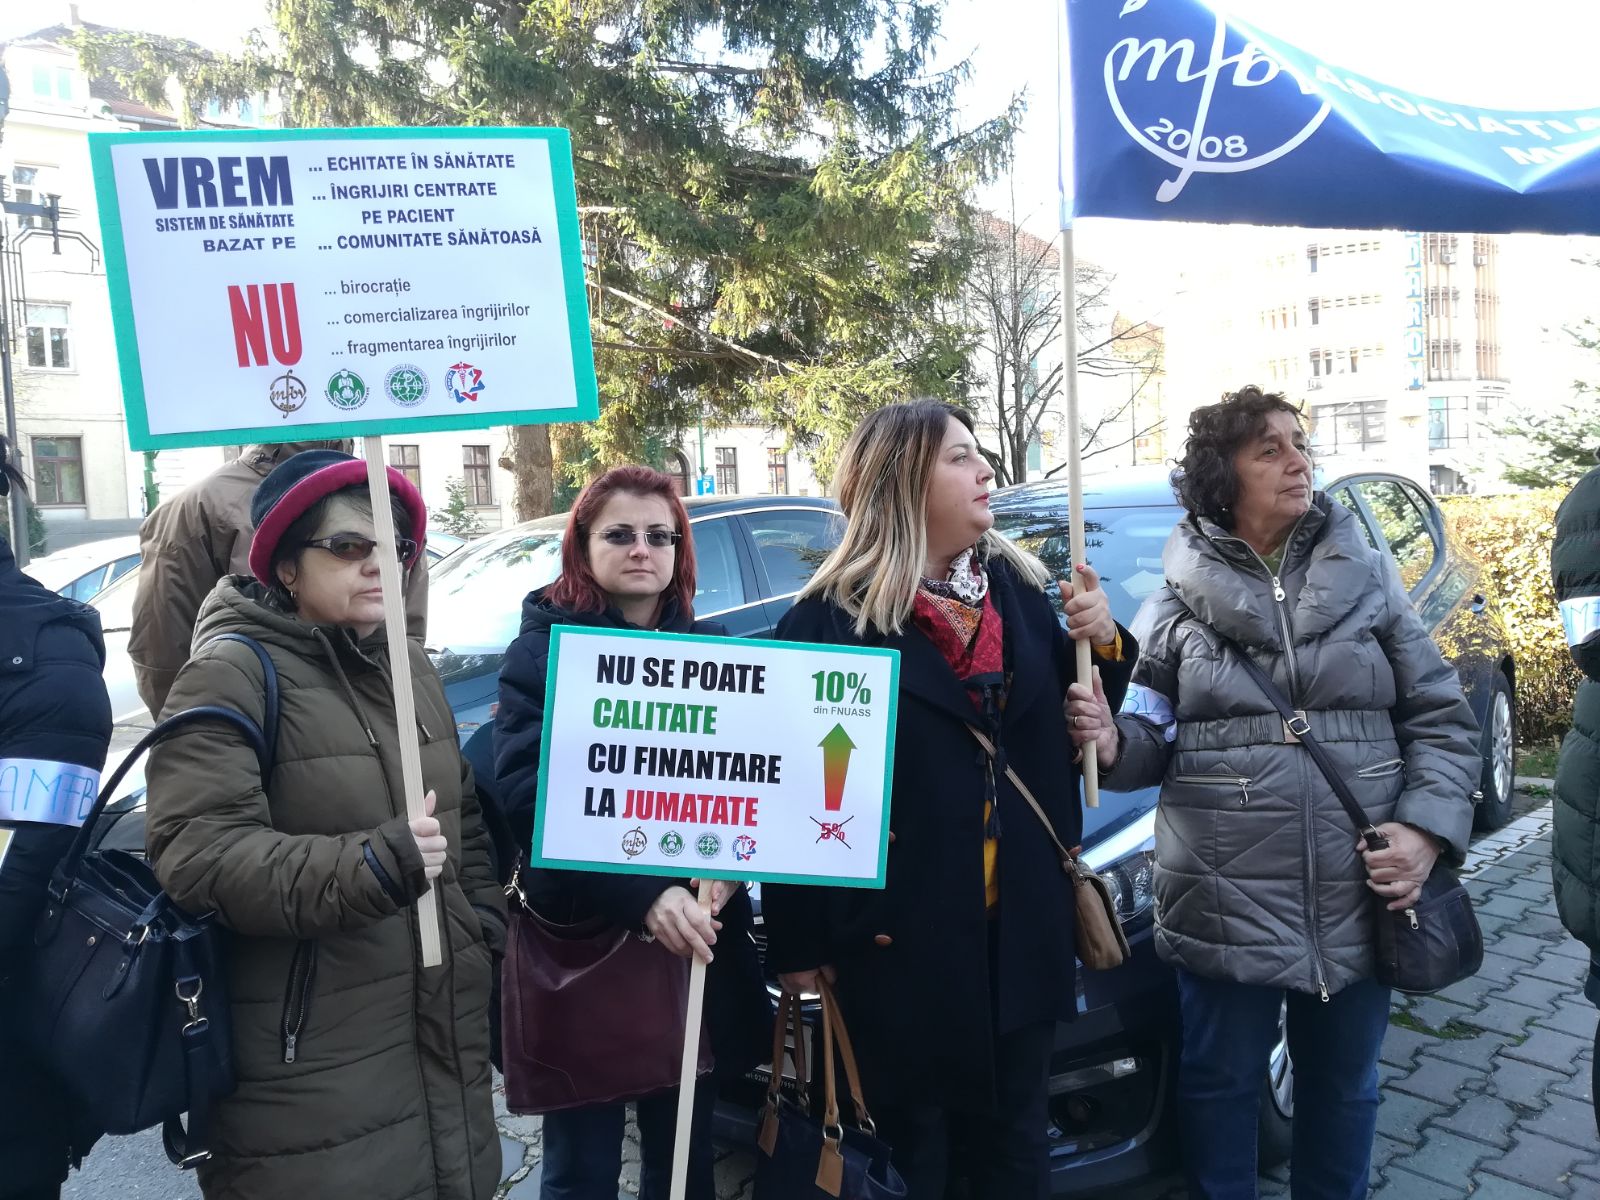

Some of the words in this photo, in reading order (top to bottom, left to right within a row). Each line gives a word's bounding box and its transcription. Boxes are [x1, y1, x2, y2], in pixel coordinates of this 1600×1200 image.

[1143, 117, 1248, 159] 2008
[327, 155, 407, 172] ECHITATE
[411, 152, 429, 169] ÎN
[434, 151, 516, 169] SĂNĂTATE
[142, 156, 294, 210] VREM
[330, 182, 409, 200] ÎNGRIJIRI
[414, 182, 498, 198] CENTRATE
[155, 215, 206, 232] SISTEM
[209, 215, 226, 230] DE
[229, 212, 295, 230] SĂNĂTATE
[361, 210, 383, 225] PE
[387, 208, 455, 224] PACIENT
[203, 237, 265, 252] BAZAT
[272, 236, 296, 250] PE
[337, 232, 443, 250] COMUNITATE
[447, 226, 542, 246] SĂNĂTOASĂ
[340, 278, 411, 297] birocrație
[227, 282, 303, 368] NU
[344, 306, 458, 325] comercializarea
[461, 302, 530, 321] îngrijirilor
[347, 337, 444, 357] fragmentarea
[447, 332, 517, 351] îngrijirilor
[596, 654, 635, 686] NU
[642, 656, 675, 689] SE
[681, 660, 766, 695] POATE
[811, 670, 872, 705] 10%
[593, 697, 718, 735] CALITATE
[813, 705, 828, 715] din
[830, 706, 871, 717] FNUASS
[587, 742, 627, 775] CU
[633, 746, 782, 785] FINANTARE
[584, 786, 616, 818] LA
[622, 789, 759, 827] JUMATATE
